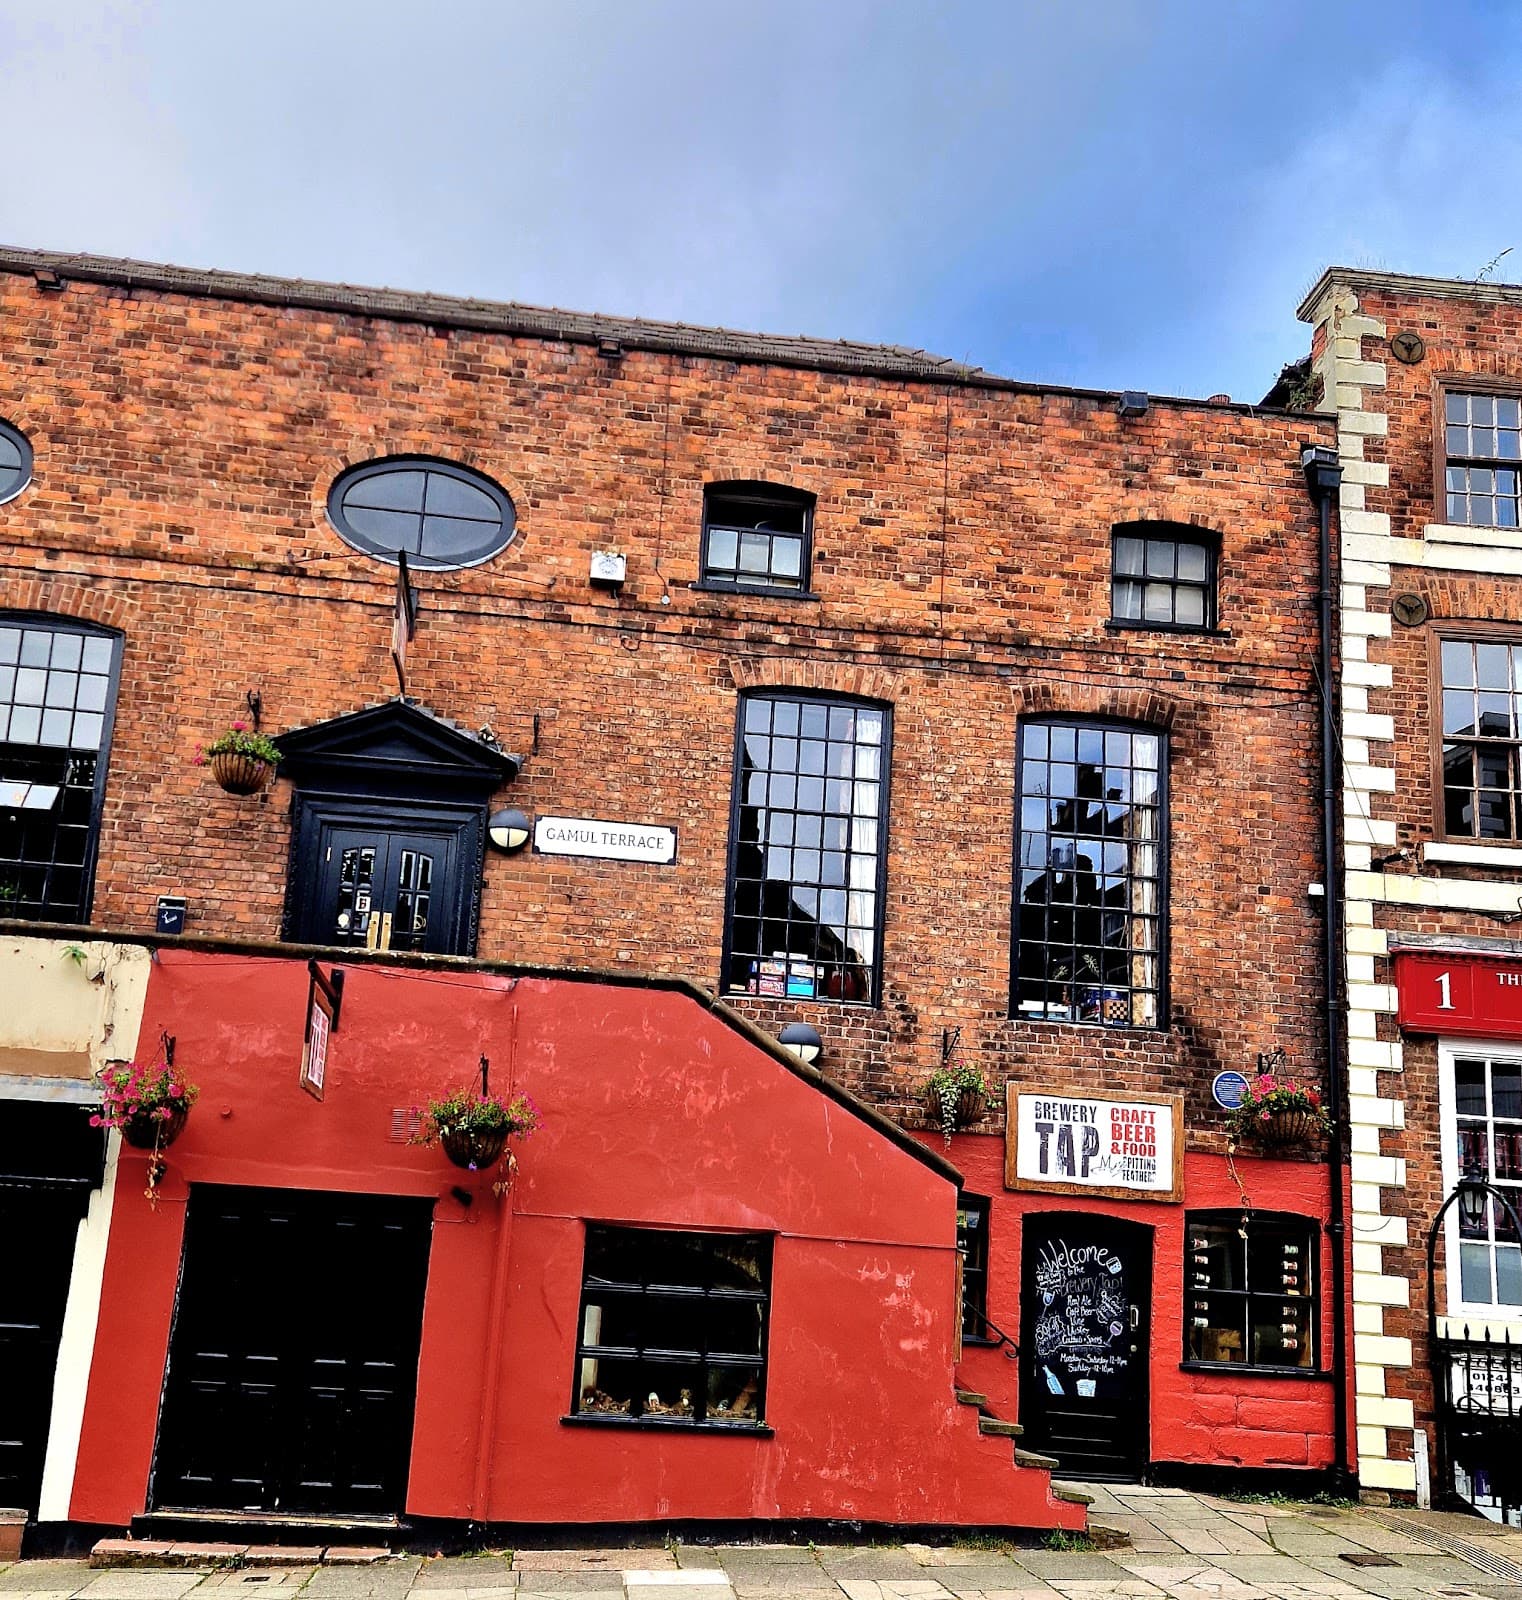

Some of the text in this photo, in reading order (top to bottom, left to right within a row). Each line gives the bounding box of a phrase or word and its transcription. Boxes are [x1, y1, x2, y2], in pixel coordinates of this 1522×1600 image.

[546, 827, 665, 850] GAMUL TERRACE
[1434, 971, 1457, 1010] 1
[1034, 1101, 1097, 1124] BREWERY
[1110, 1107, 1156, 1124] CRAFT
[1111, 1123, 1156, 1144] BEER
[1034, 1122, 1100, 1178] TAP
[1040, 1238, 1109, 1273] Welcome
